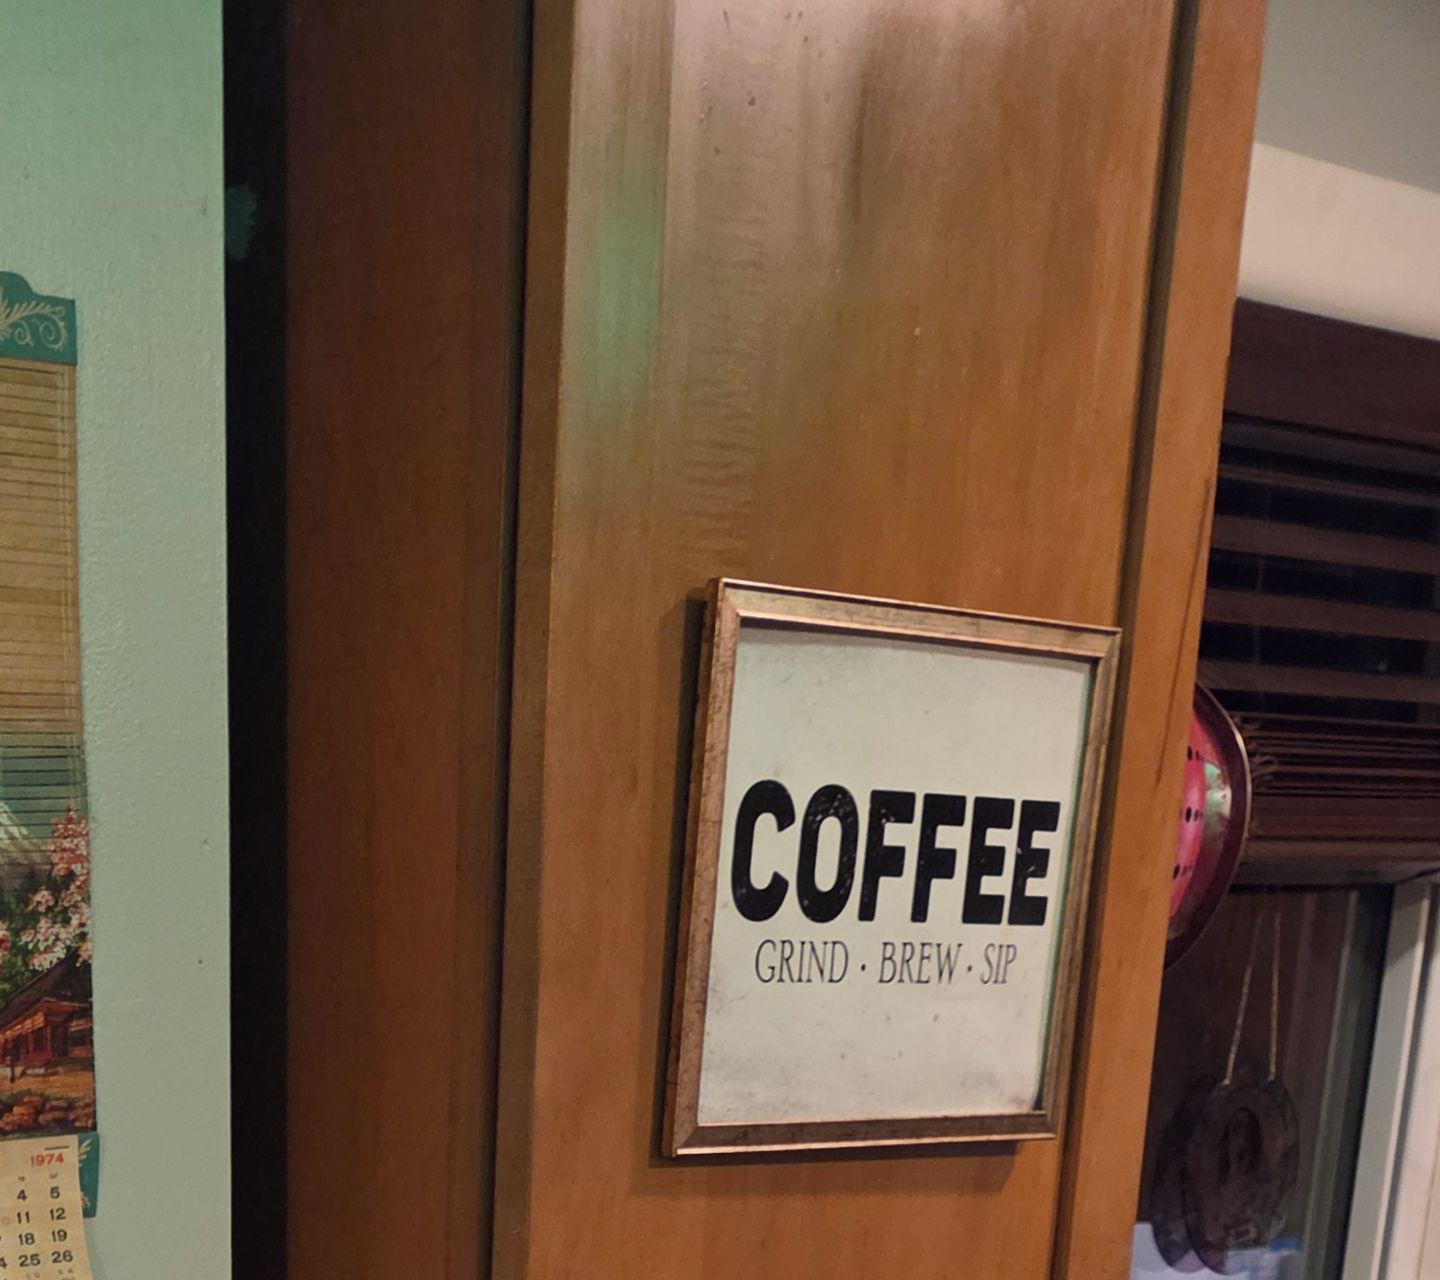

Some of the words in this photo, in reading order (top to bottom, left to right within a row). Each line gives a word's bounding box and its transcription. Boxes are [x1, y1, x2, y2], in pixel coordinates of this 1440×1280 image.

[731, 779, 1060, 926] COFFEE
[755, 938, 849, 984] GRIND
[878, 941, 963, 985] BREW
[980, 943, 1017, 985] SIP
[30, 1152, 64, 1167] 1974
[16, 1189, 27, 1201] 4
[50, 1186, 61, 1199] 5
[16, 1211, 30, 1224] 11
[49, 1207, 66, 1221] 12
[18, 1232, 36, 1246] 18
[51, 1229, 68, 1242] 19
[18, 1253, 41, 1268] 25
[51, 1249, 74, 1263] 26
